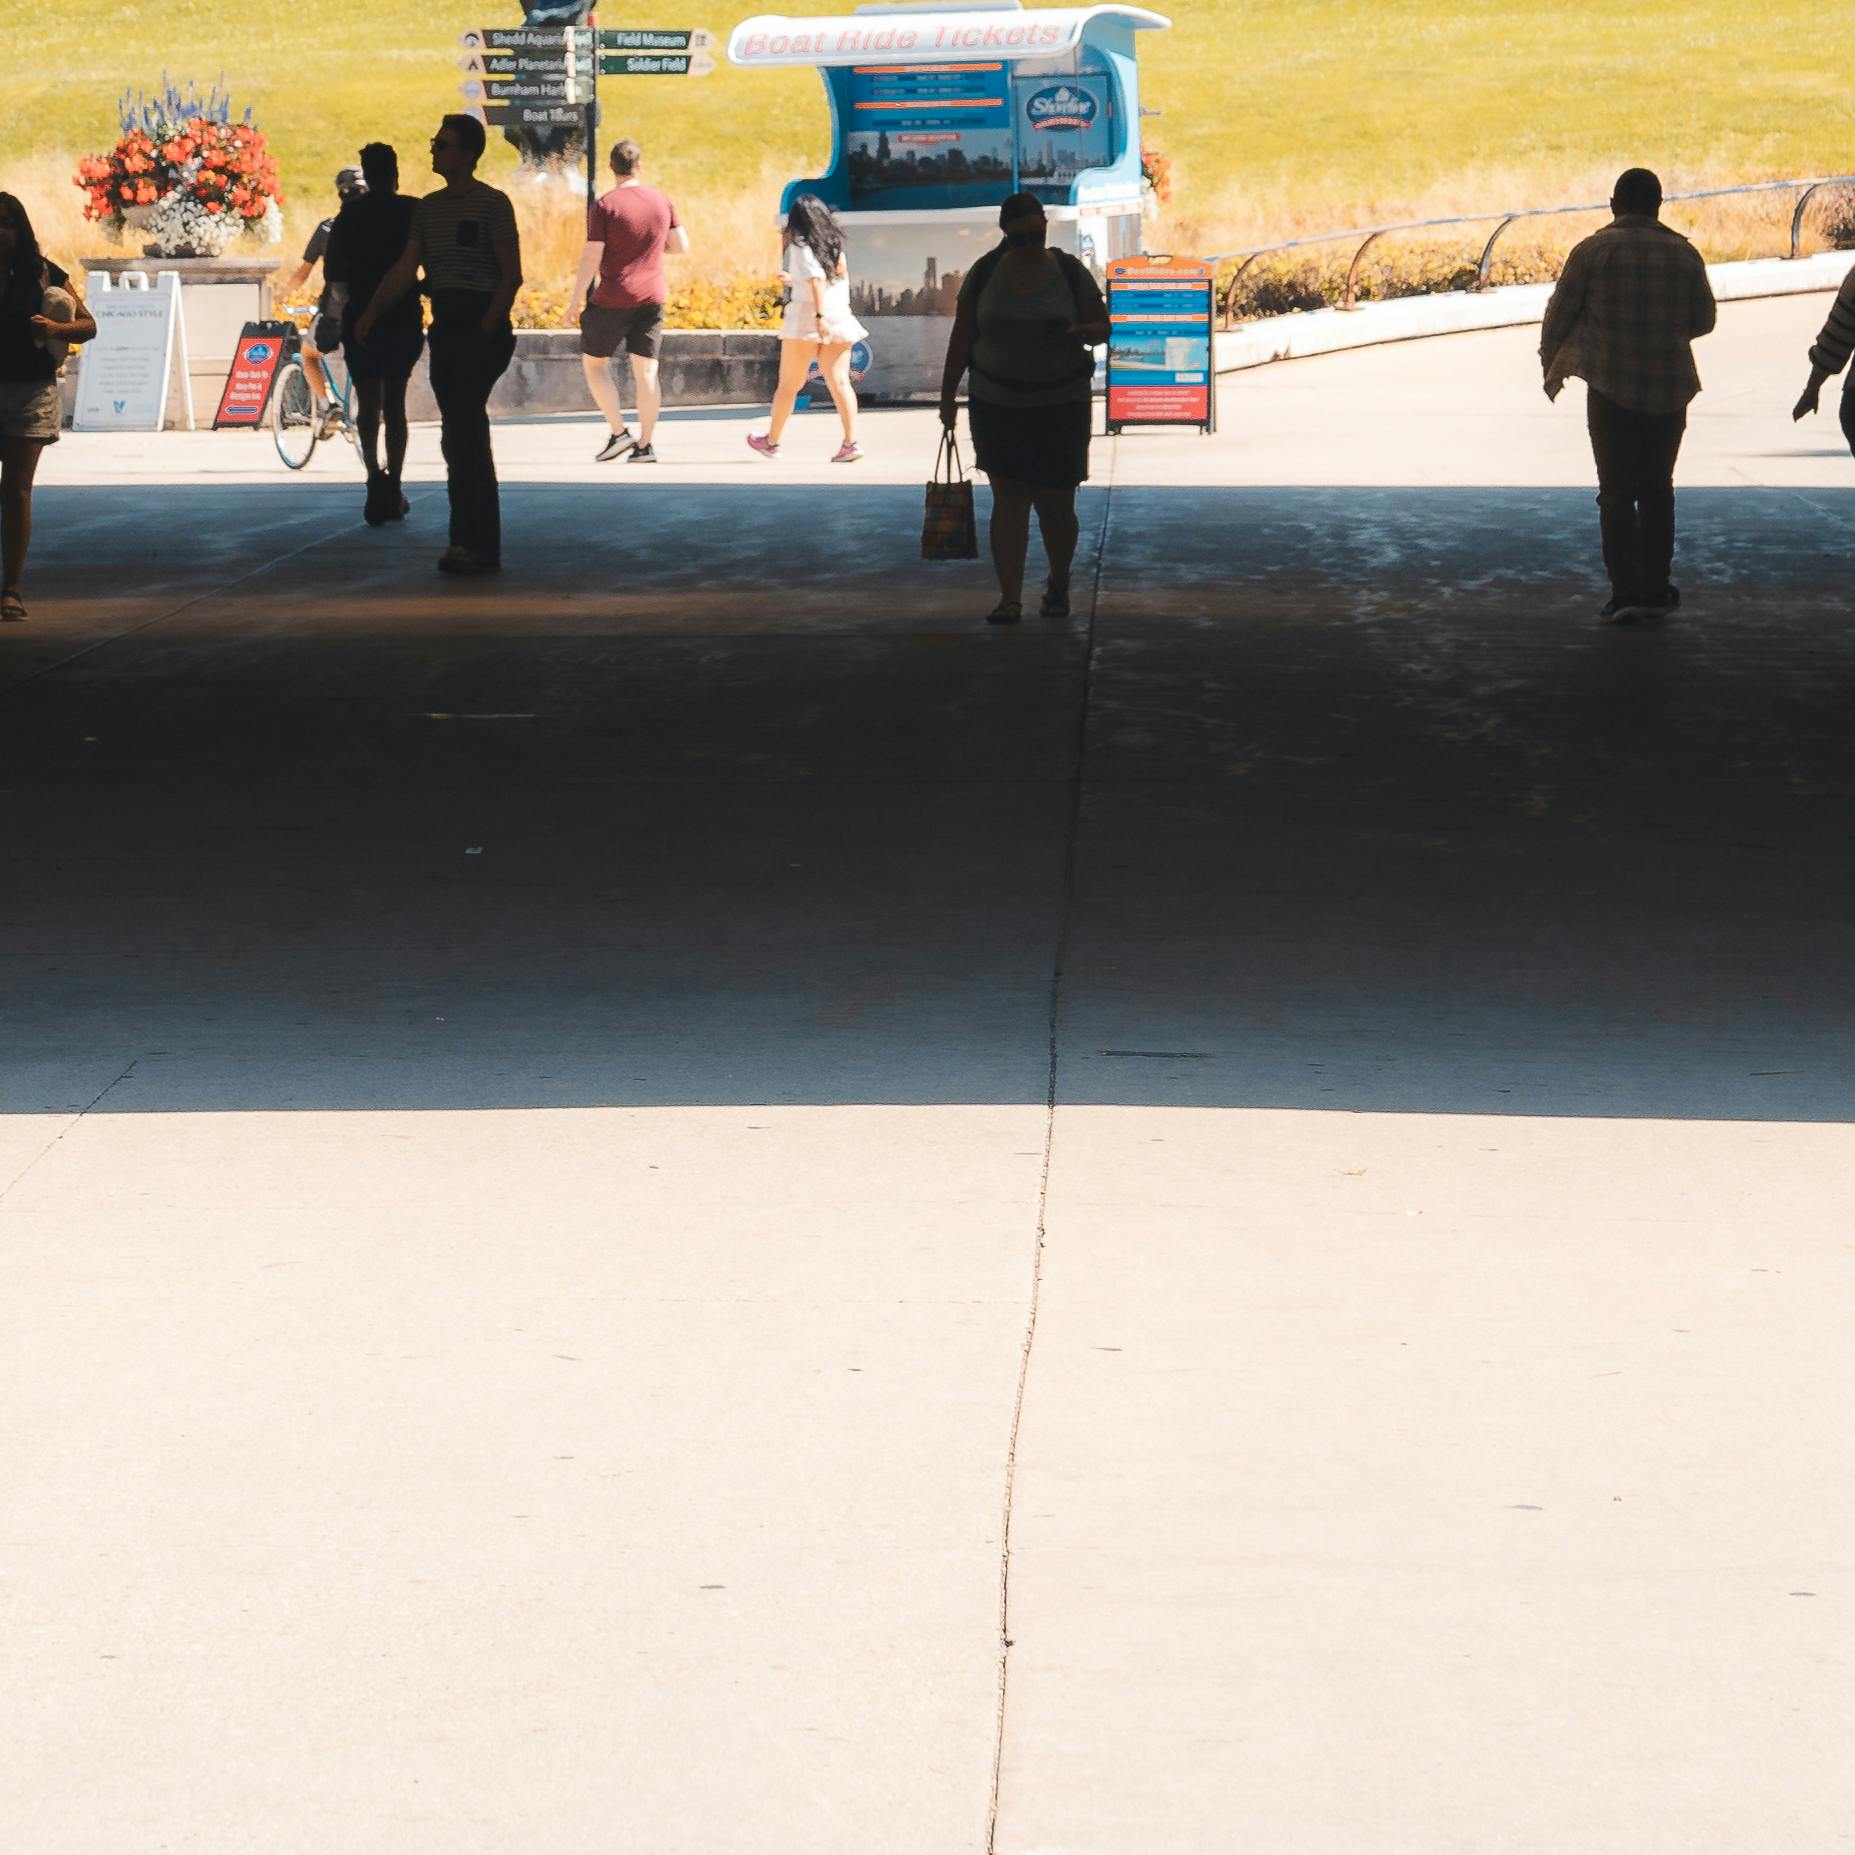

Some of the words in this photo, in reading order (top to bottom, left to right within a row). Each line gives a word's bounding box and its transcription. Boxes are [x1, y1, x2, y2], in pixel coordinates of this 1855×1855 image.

[617, 32, 641, 45] Field
[642, 32, 687, 46] Museum
[744, 31, 826, 55] Boat
[837, 28, 919, 51] Ride
[933, 23, 1061, 48] Tickets
[626, 57, 661, 72] Soldier
[661, 57, 687, 72] Field
[522, 108, 548, 122] Boat
[138, 310, 163, 319] STYLE
